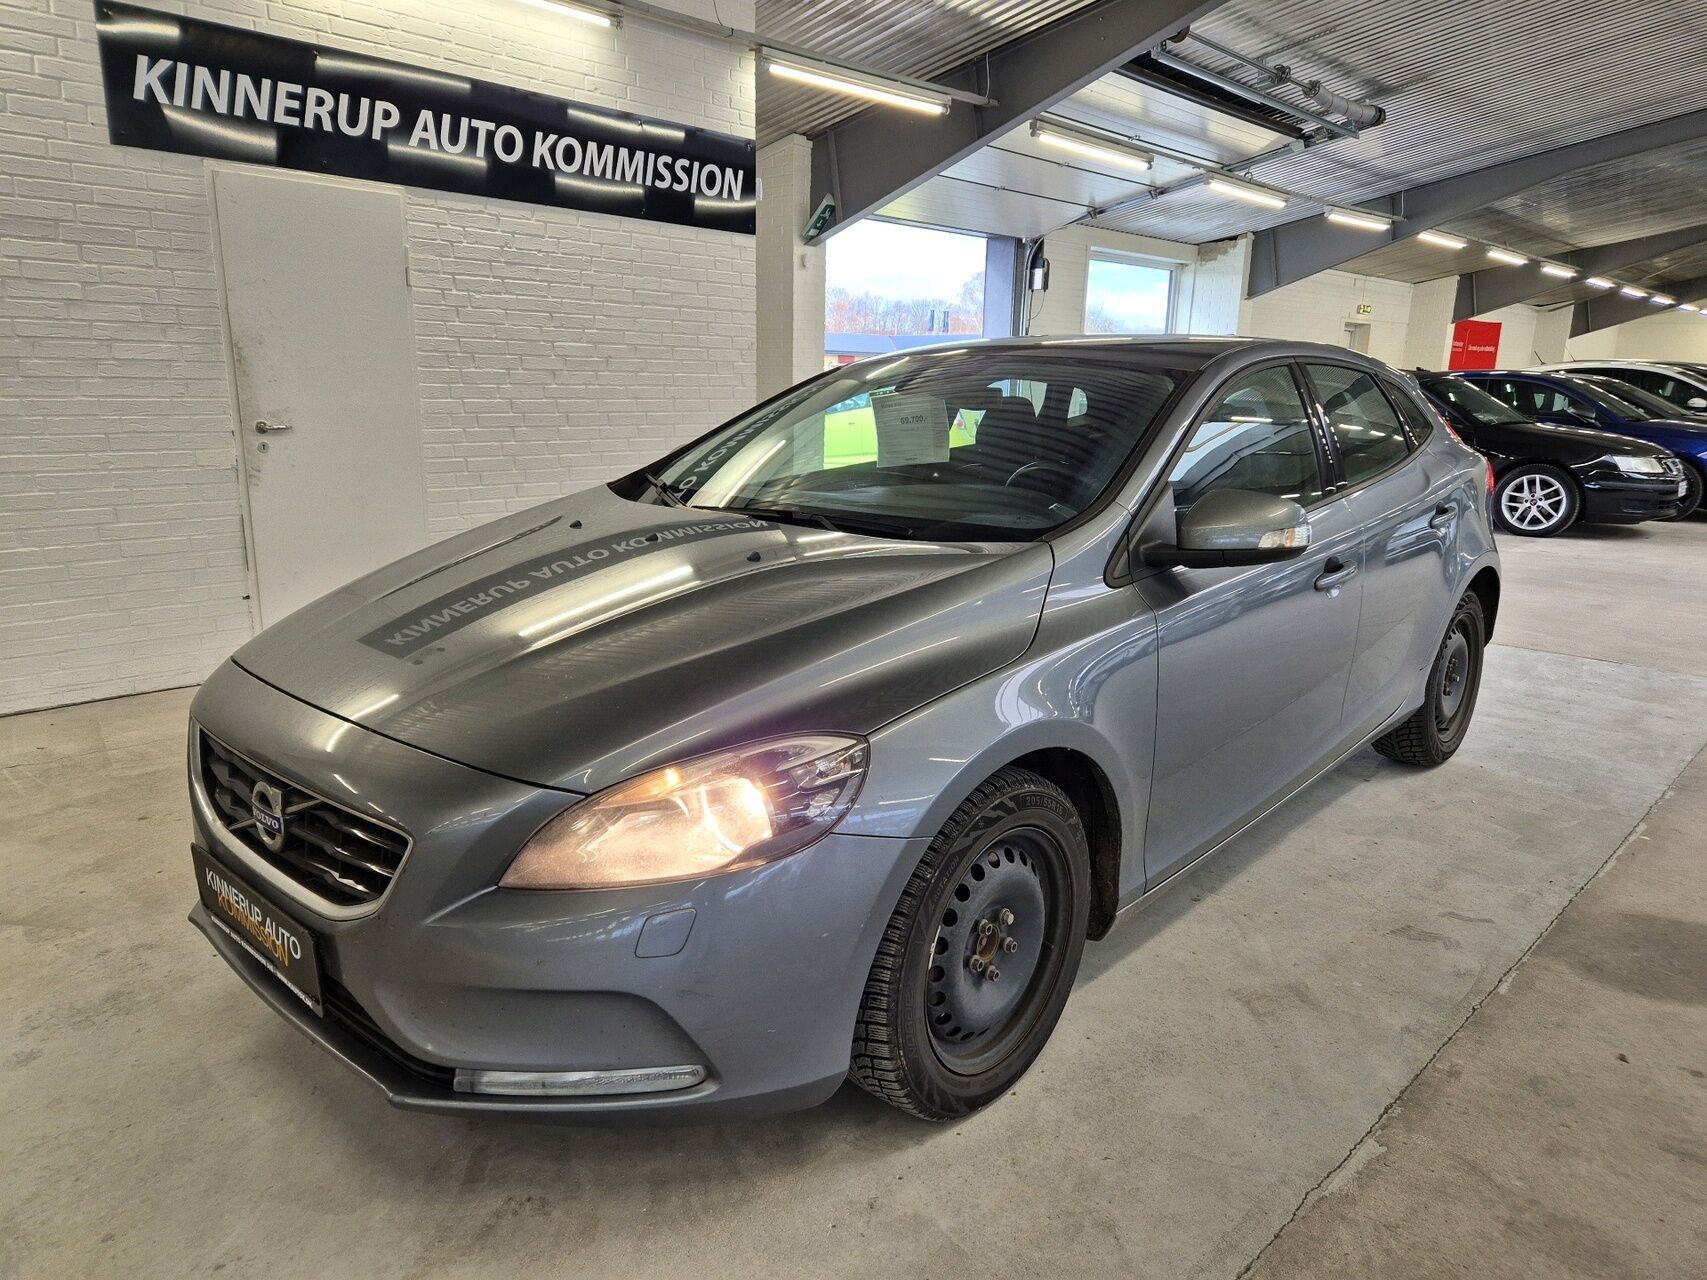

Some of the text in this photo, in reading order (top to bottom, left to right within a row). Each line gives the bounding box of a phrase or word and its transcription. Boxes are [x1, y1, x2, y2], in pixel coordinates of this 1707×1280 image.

[132, 53, 745, 201] KINNERUP AUTO KOMMISSION
[252, 806, 279, 829] VOLVO
[205, 867, 302, 960] KINNERUP AUTO
[218, 891, 289, 967] KOMMISSION
